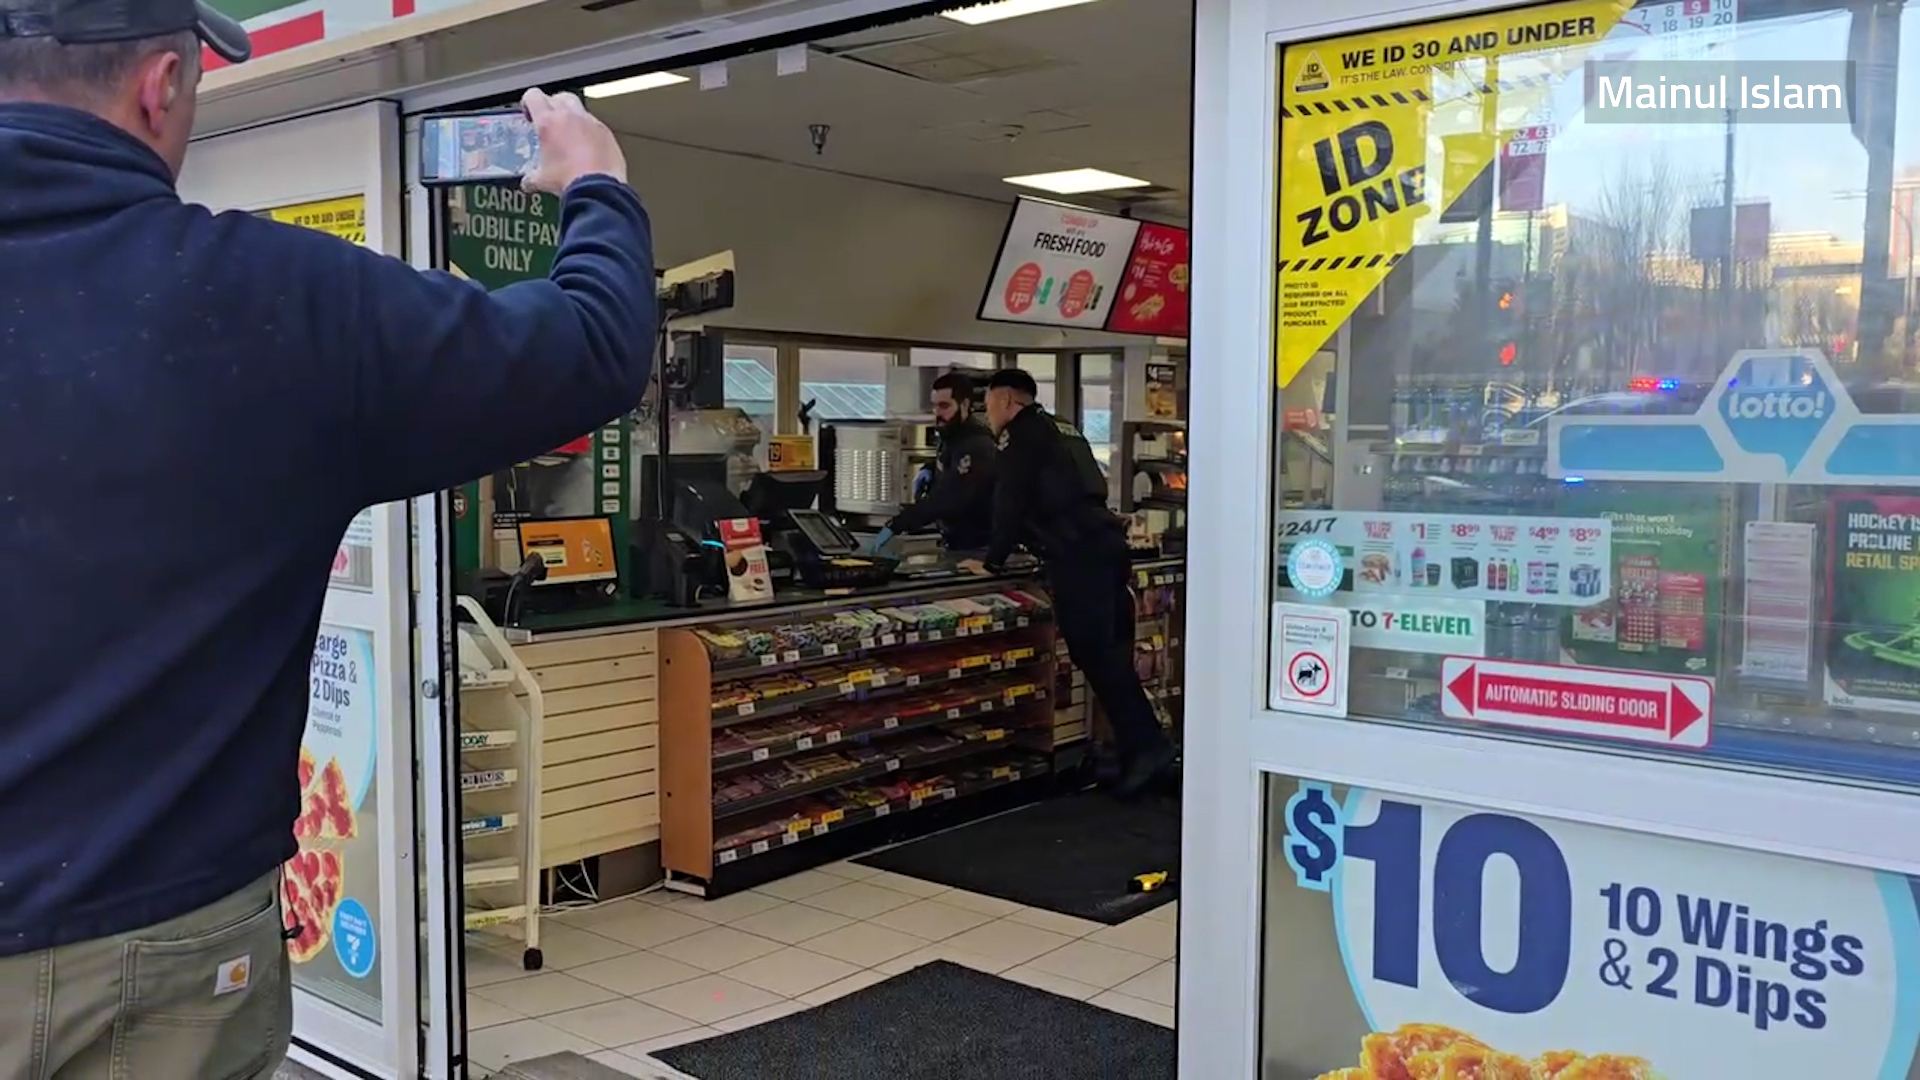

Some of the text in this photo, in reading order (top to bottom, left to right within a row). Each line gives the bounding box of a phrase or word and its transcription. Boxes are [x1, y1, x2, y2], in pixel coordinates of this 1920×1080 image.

[1662, 20, 1677, 32] 18
[1689, 16, 1703, 29] 19
[1714, 12, 1732, 25] 20
[1665, 5, 1675, 17] 8
[1341, 49, 1375, 69] WE
[1383, 46, 1405, 64] ID
[1412, 40, 1440, 60] 30
[1448, 31, 1498, 55] AND
[1507, 16, 1595, 45] UNDER
[1307, 63, 1319, 73] ID
[1361, 70, 1379, 82] THE
[1313, 120, 1394, 196] ID
[1513, 143, 1529, 154] 72
[474, 185, 543, 217] CARD &
[1296, 164, 1425, 247] ZONE
[528, 221, 560, 246] PAY
[1033, 232, 1106, 258] FRESH FOOD
[484, 245, 533, 273] ONLY
[1729, 391, 1825, 419] lotto!
[1285, 517, 1337, 537] 24/7
[1656, 525, 1693, 538] holiday
[1848, 512, 1906, 531] HOCKEY
[1846, 552, 1895, 569] RETAIL
[1349, 610, 1377, 628] TO
[314, 634, 347, 660] arge
[312, 653, 358, 684] Pizza &
[313, 677, 350, 709] 2 Dips
[1485, 683, 1658, 719] AUTOMATIC SLIDING DOOR
[1600, 883, 1865, 982] 10 Wings
[1599, 938, 1828, 1031] & 2 Dips
